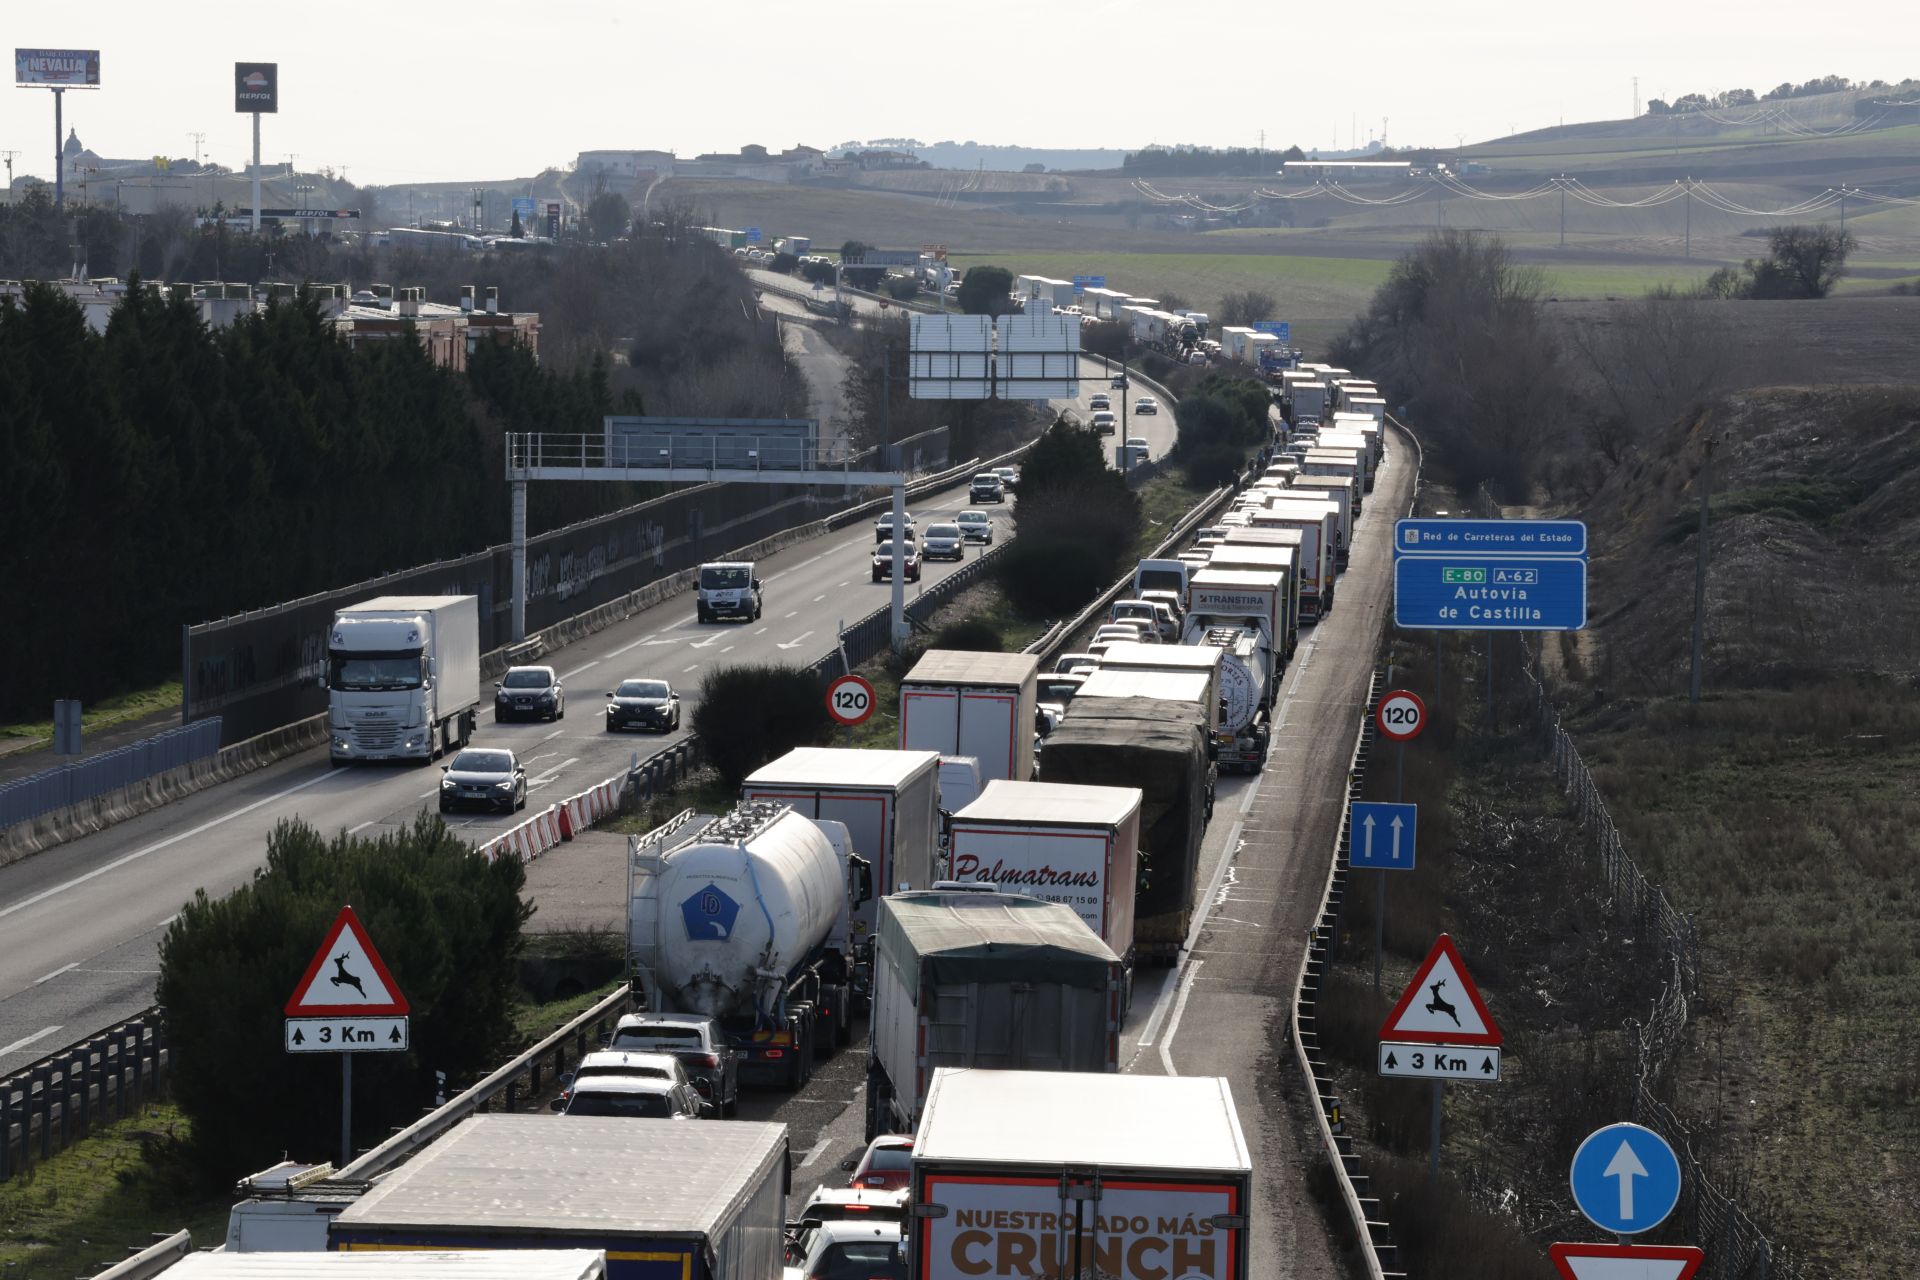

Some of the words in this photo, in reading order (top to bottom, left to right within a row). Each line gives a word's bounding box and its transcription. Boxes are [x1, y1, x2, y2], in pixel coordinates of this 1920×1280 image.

[28, 57, 84, 73] NEVALIA
[1423, 532, 1442, 541] Red
[1447, 533, 1459, 541] de
[1464, 533, 1515, 542] Carreteras
[1521, 533, 1534, 542] del
[1540, 533, 1572, 542] Estado
[1446, 570, 1483, 581] E-80
[1496, 571, 1534, 582] A-62
[1208, 595, 1264, 605] TRANSTIRA
[1439, 606, 1458, 619] de
[1469, 605, 1541, 619] Castilla
[835, 691, 868, 709] 120
[1385, 707, 1418, 725] 120
[956, 854, 1099, 887] Palmatrans
[1045, 894, 1061, 903] 948
[1063, 895, 1073, 903] 67
[1076, 896, 1085, 904] 15
[1087, 896, 1098, 905] 00
[319, 1026, 332, 1043] 3
[342, 1026, 375, 1043] Km
[1411, 1053, 1424, 1069] 3
[1434, 1054, 1467, 1072] Km
[955, 1209, 1077, 1232] NUESTRO
[1157, 1212, 1215, 1236] MÁS
[951, 1229, 1215, 1280] CRUNCH
